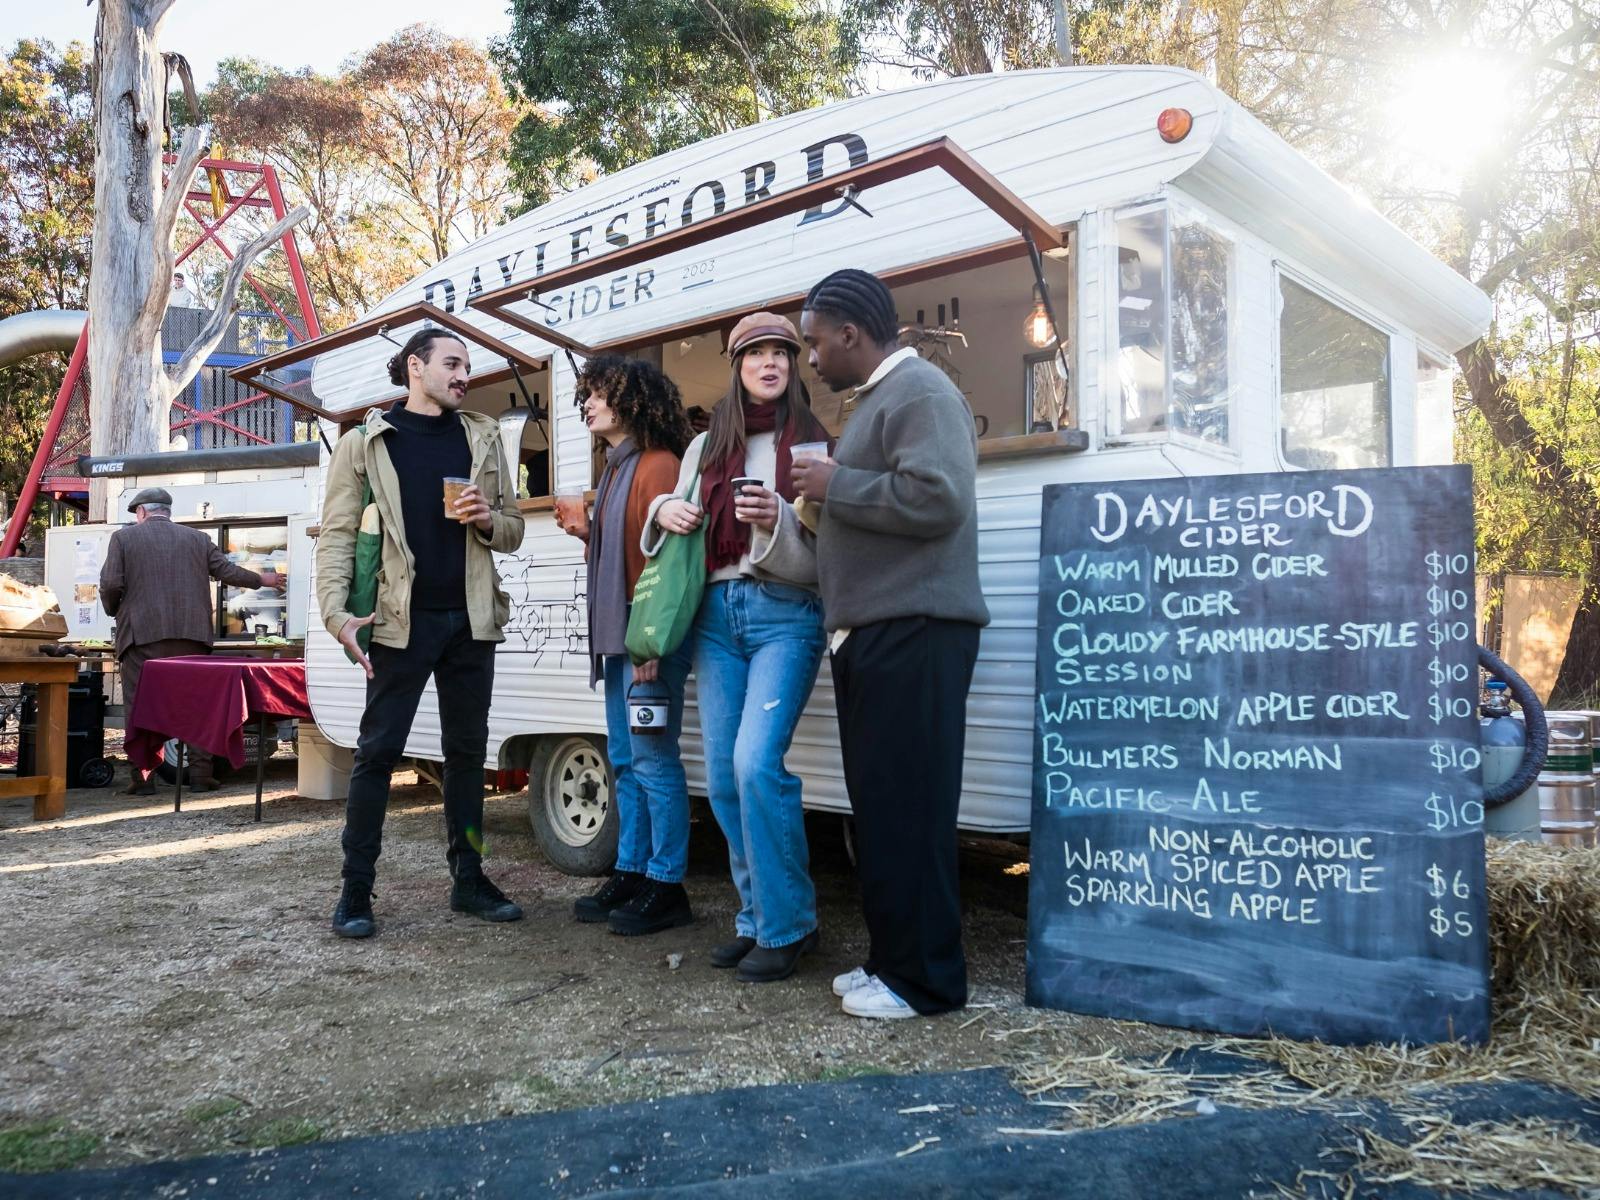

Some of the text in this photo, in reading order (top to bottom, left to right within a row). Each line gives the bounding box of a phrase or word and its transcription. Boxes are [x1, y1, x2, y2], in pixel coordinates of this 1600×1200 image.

[683, 259, 716, 280] 2003
[544, 267, 655, 326] CIDER
[92, 462, 124, 474] KINGS
[1090, 485, 1374, 543] DAYLESFORD
[1179, 522, 1292, 548] CIDER
[1054, 550, 1468, 584] WARM MULLED CIDER $10
[1056, 584, 1468, 620] OAKED CIDER $10
[1053, 619, 1469, 657] CLOUDY FARMHOUSE-STYLE $10
[1056, 655, 1469, 688] SESSION $10
[1039, 692, 1471, 726] WATERMELON APPLE CIDER $10
[1042, 733, 1481, 775] BULMERS NORMAN $10
[1045, 771, 1485, 832] PACIFIC ALE $10
[1149, 825, 1376, 862] NON-ALCOHOLIC
[1064, 837, 1152, 884] WARM
[1170, 853, 1282, 889] SPICED
[1295, 864, 1384, 894] APPLE
[1065, 875, 1213, 919] SPARKLING
[1230, 894, 1322, 926] APPLE
